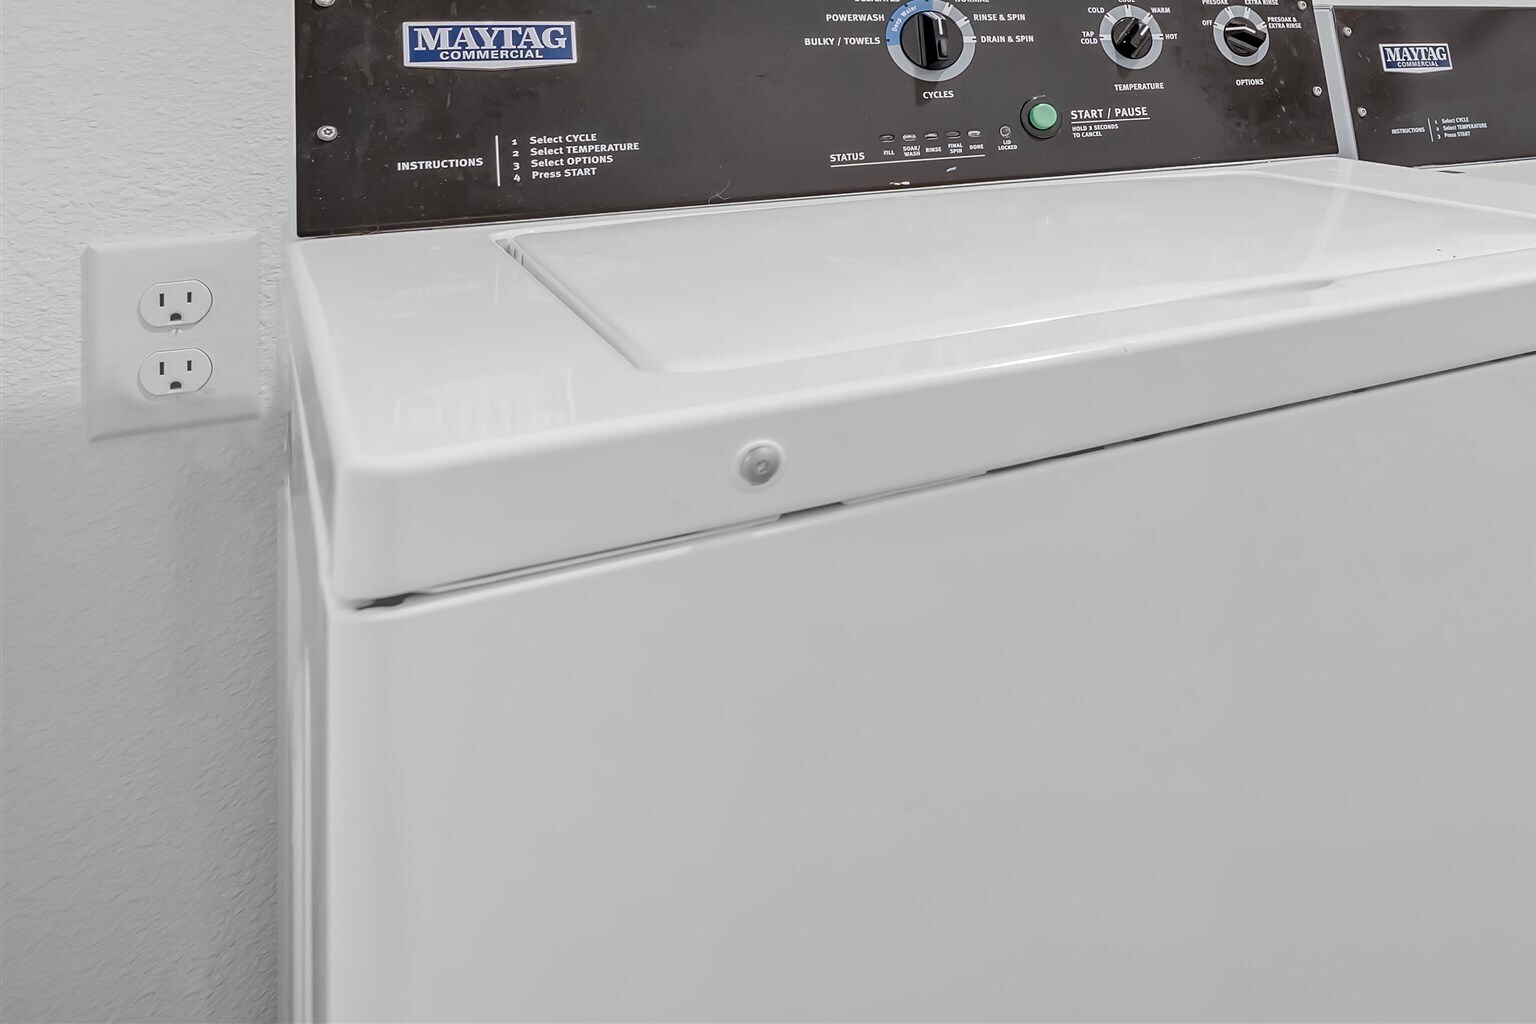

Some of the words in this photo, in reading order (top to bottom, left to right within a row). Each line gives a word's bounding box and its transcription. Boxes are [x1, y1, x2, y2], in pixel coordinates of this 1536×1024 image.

[826, 13, 885, 22] POWERWASH
[891, 18, 902, 33] Deep
[900, 5, 917, 17] Water
[973, 13, 998, 21] RINSE
[999, 13, 1006, 21] &
[1007, 13, 1026, 21] SPIN
[414, 27, 567, 51] MAYTAG
[804, 38, 835, 46] BULKY
[837, 37, 842, 47] /
[844, 36, 881, 45] TOWELS
[980, 35, 1006, 43] DRAIN
[1007, 35, 1014, 43] &
[1015, 35, 1034, 43] SPIN
[440, 49, 544, 61] COMMERCIAL
[1384, 47, 1447, 62] MAYTAG
[1397, 60, 1439, 68] COMMERCIAL
[1114, 82, 1164, 92] TEMPERATURE
[1235, 78, 1264, 86] OPTIONS
[922, 90, 954, 99] CYCLES
[1070, 109, 1104, 120] START
[1114, 107, 1148, 117] PAUSE
[1391, 127, 1426, 135] INSTRUCTIONS
[511, 138, 518, 146] 1
[530, 135, 563, 144] Select
[565, 133, 597, 143] CYCLE
[530, 147, 564, 156] Select
[566, 142, 639, 154] TEMPERATURE
[830, 152, 866, 162] STATUS
[397, 157, 484, 171] INSTRUCTIONS
[512, 162, 520, 171] 3
[530, 158, 565, 168] Select
[567, 155, 614, 165] OPTIONS
[513, 173, 521, 182] 4
[532, 170, 562, 180] Press
[564, 167, 597, 177] START
